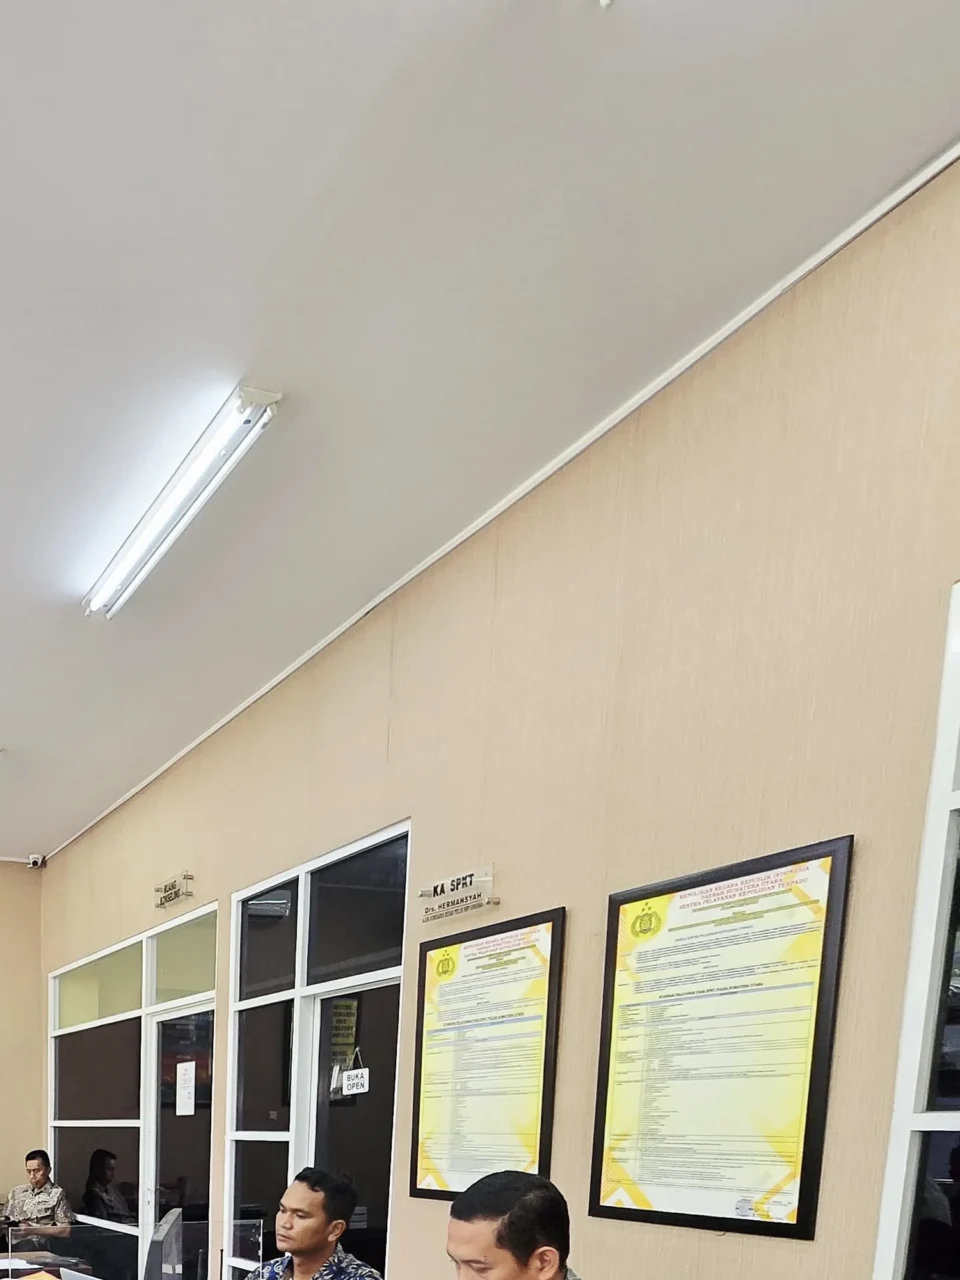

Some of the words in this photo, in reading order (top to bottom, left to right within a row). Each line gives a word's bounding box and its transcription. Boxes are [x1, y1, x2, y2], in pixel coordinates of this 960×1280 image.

[432, 883, 445, 897] KA
[450, 873, 474, 892] SPKT
[438, 892, 482, 910] HERMANSYAH
[347, 1072, 364, 1081] BUKA
[347, 1082, 364, 1091] OPEN
